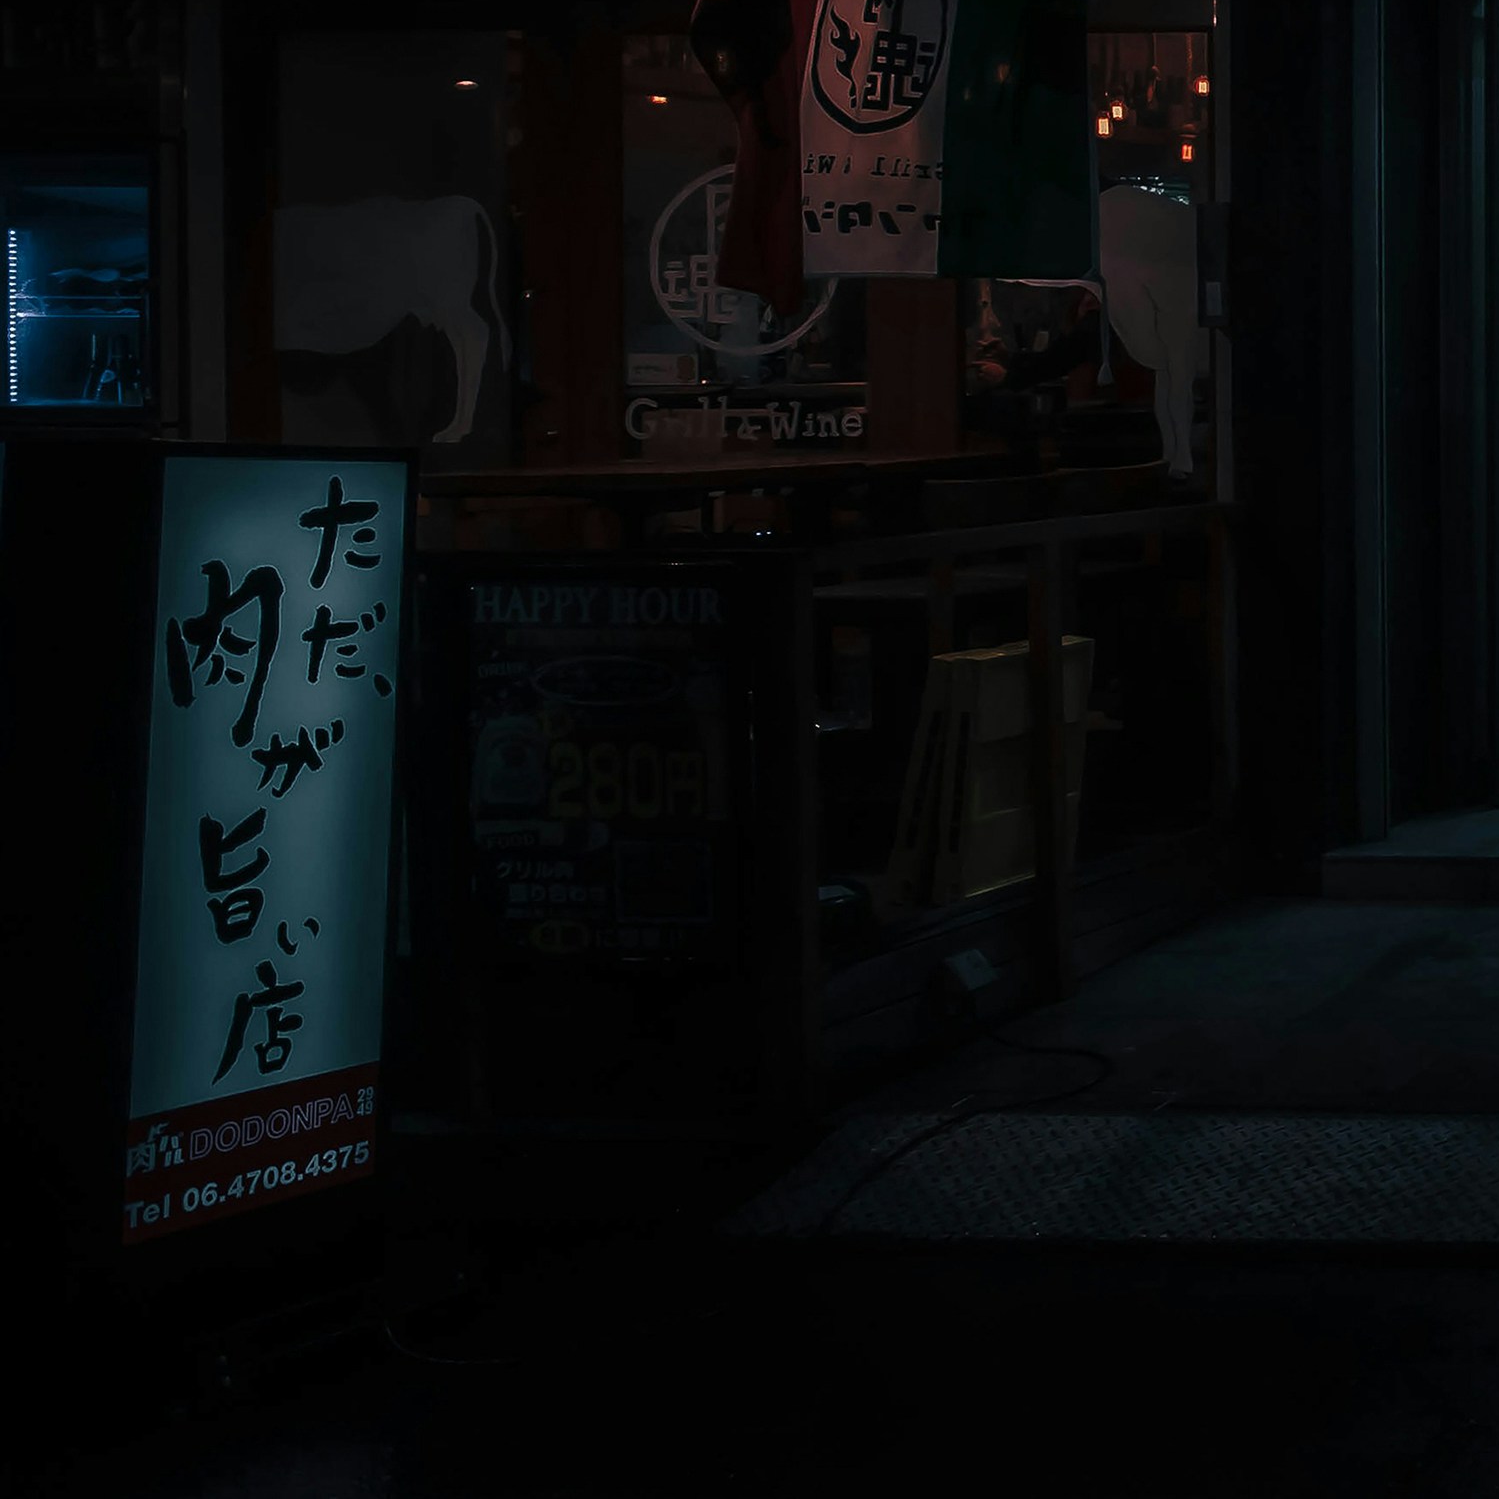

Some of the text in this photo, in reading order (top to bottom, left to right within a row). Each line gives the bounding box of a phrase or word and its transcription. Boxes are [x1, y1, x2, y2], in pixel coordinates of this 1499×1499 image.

[766, 400, 864, 441] Wine
[474, 585, 724, 625] HAPPY HOUR
[189, 1092, 355, 1161] DODONPA
[124, 1139, 370, 1230] Tel 06.4708.4375
